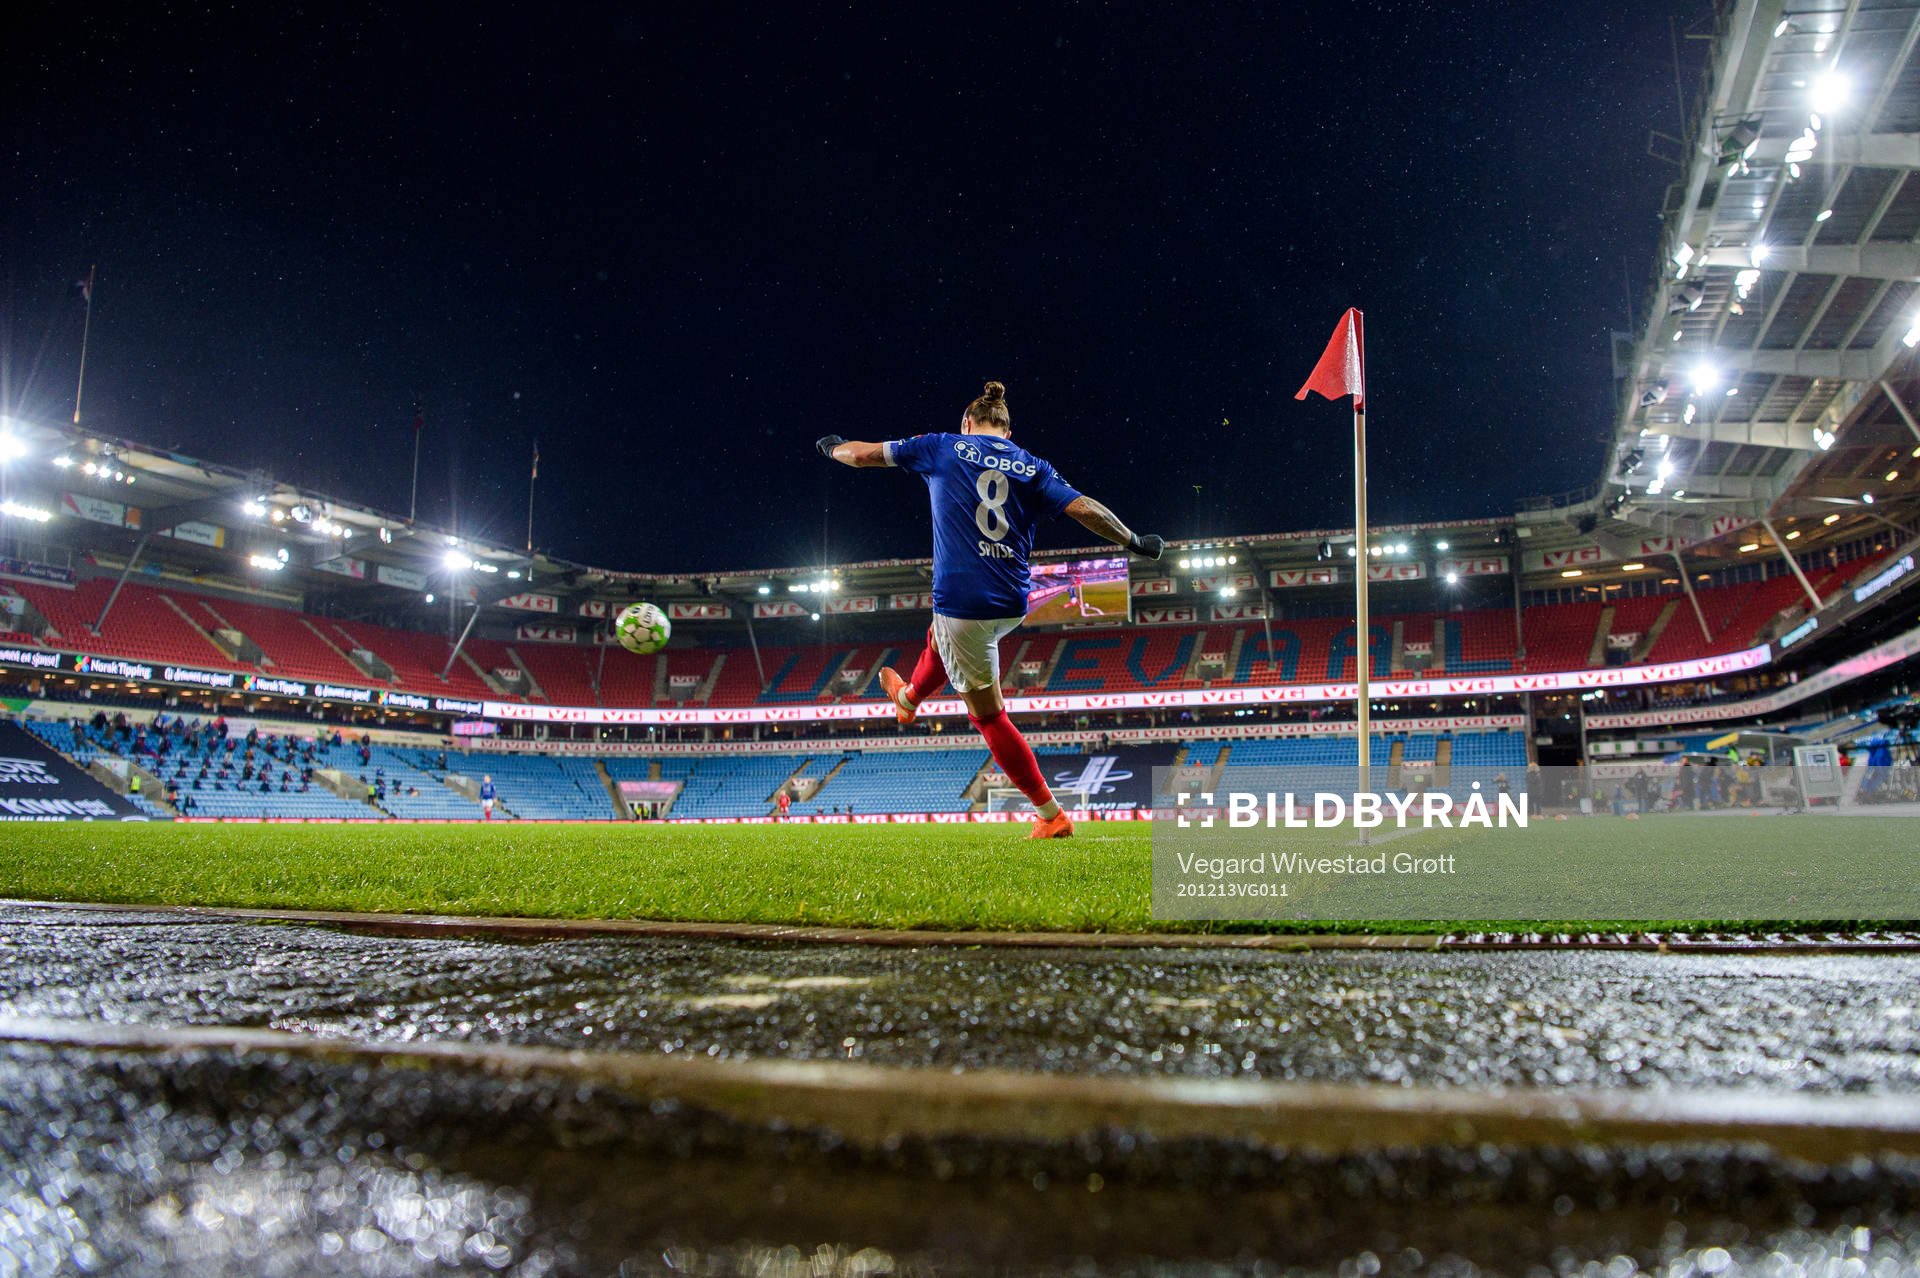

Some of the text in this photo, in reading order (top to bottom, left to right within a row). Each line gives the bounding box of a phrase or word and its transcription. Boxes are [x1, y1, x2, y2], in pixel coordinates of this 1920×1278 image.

[983, 456, 1036, 477] OBOS
[976, 470, 1009, 541] 8
[1543, 546, 1600, 567] VG
[1368, 564, 1422, 581] VG
[1440, 560, 1502, 576] VG
[1277, 569, 1334, 586] VG
[673, 605, 728, 619] VG
[825, 598, 872, 612] VG
[1213, 605, 1270, 620] VG
[1140, 609, 1196, 623] VG
[524, 628, 573, 642] VG
[90, 659, 118, 674] Norsk
[118, 661, 152, 679] Tipping
[256, 678, 278, 692] Norsk
[278, 680, 306, 696] Tipping
[502, 706, 534, 719] VG
[549, 708, 587, 720] VG
[603, 709, 642, 721] VG
[660, 709, 698, 721] VG
[715, 709, 750, 721] VG
[765, 708, 800, 720] VG
[816, 707, 850, 718] VG
[919, 702, 958, 714] VG
[1029, 697, 1068, 710] VG
[1086, 695, 1126, 708] VG
[1143, 693, 1184, 706] VG
[1203, 690, 1243, 703] VG
[1262, 687, 1304, 700] VG
[1386, 682, 1430, 695] VG
[1450, 679, 1494, 692] VG
[1514, 675, 1559, 689] VG
[1578, 671, 1623, 685] VG
[1641, 665, 1684, 680] VG
[1699, 657, 1732, 673] VG
[1050, 733, 1075, 741] VG
[1080, 732, 1104, 740] VG
[1111, 731, 1138, 739] VG
[1144, 729, 1171, 737] VG
[1177, 728, 1205, 737] VG
[1211, 727, 1239, 735] VG
[1244, 726, 1272, 734] VG
[1278, 724, 1307, 733] VG
[1313, 723, 1342, 731] VG
[1383, 721, 1413, 729] VG
[1418, 719, 1448, 728] VG
[1454, 718, 1485, 726] VG
[1490, 716, 1521, 725] VG
[815, 814, 850, 824] VG
[853, 814, 888, 824] VG
[890, 813, 928, 823] VG
[931, 812, 968, 823] VG
[971, 812, 1009, 823] VG
